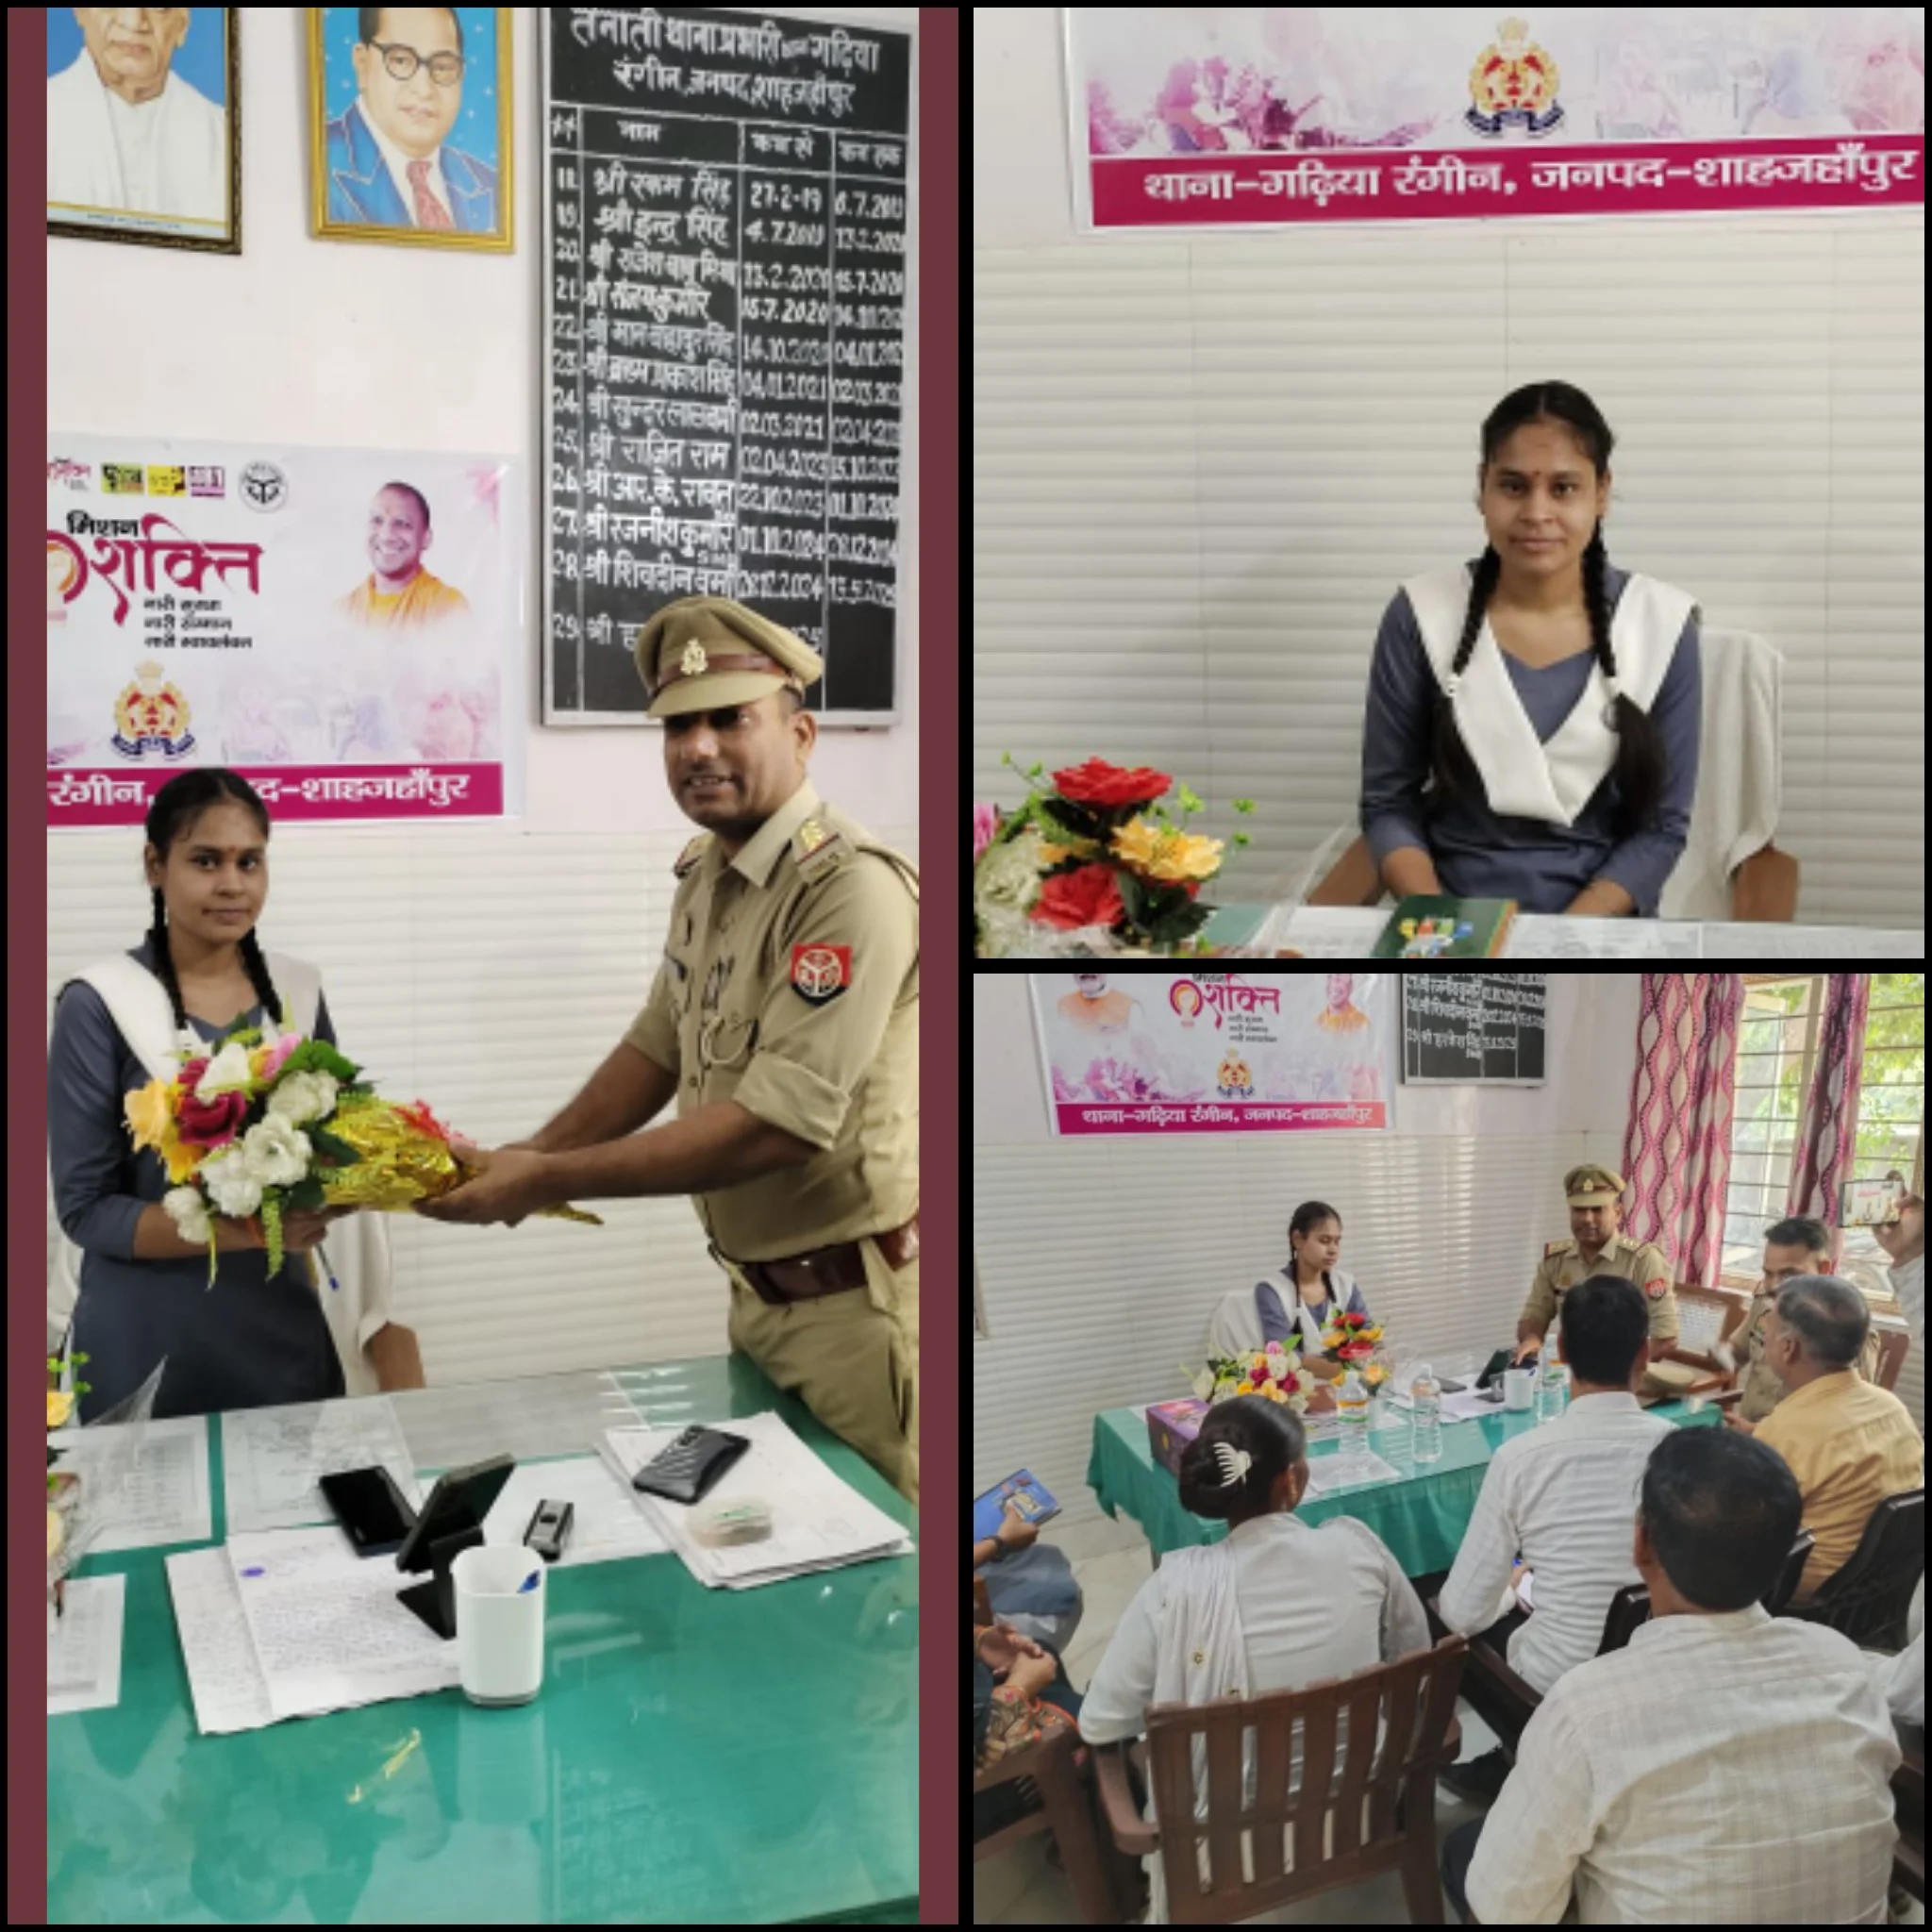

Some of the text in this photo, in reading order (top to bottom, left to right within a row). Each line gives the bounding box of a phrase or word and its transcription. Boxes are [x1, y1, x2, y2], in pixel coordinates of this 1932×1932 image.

[592, 161, 628, 196] श्री
[1144, 142, 1920, 207] थाना-गढ़िया रंगीन, जनपद-शाहजहाँपुर
[593, 197, 636, 234] श्री
[587, 236, 615, 274] श्री
[584, 271, 612, 309] श्री
[584, 310, 609, 347] श्री
[583, 343, 609, 381] श्री
[586, 382, 612, 421] श्री
[589, 423, 616, 462] श्री
[689, 436, 734, 473] राम
[584, 460, 612, 498] श्री
[66, 509, 139, 537] मिशन
[584, 502, 610, 541] श्री
[91, 512, 265, 627] शक्ति
[584, 548, 611, 587] श्री
[586, 612, 613, 645] श्री
[244, 768, 470, 807] द-शाहजहाँपुर
